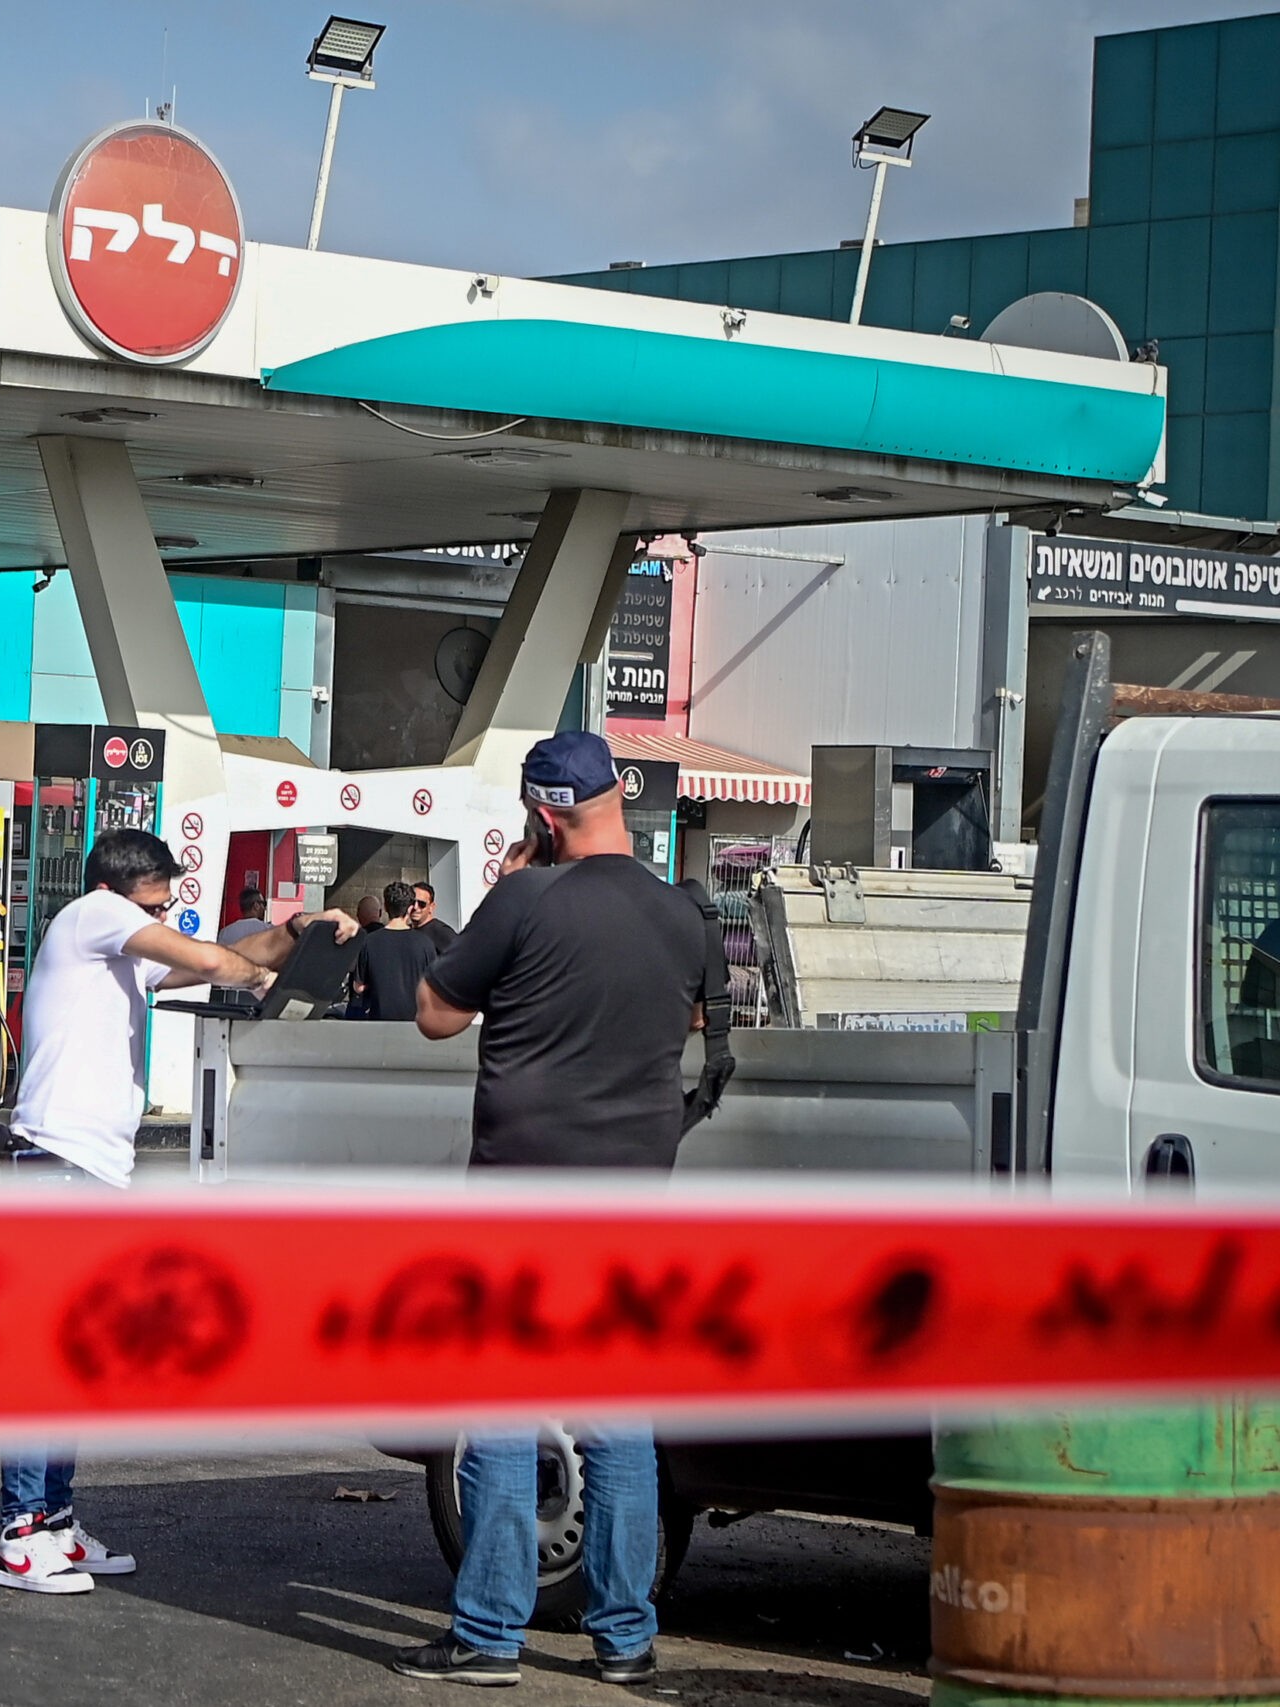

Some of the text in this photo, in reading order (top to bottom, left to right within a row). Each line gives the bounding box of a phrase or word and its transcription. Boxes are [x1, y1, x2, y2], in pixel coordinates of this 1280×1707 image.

[70, 203, 237, 277] דלק
[628, 560, 661, 576] EAM
[1036, 545, 1280, 596] טיפה אוטובוסים ומשאיות
[625, 592, 666, 607] שטיפת
[1054, 585, 1165, 608] חנות אביזרים לרכב
[624, 612, 665, 627] שטיפת
[624, 631, 665, 646] שטיפת
[622, 667, 664, 689] חנות
[529, 787, 569, 803] OLICE
